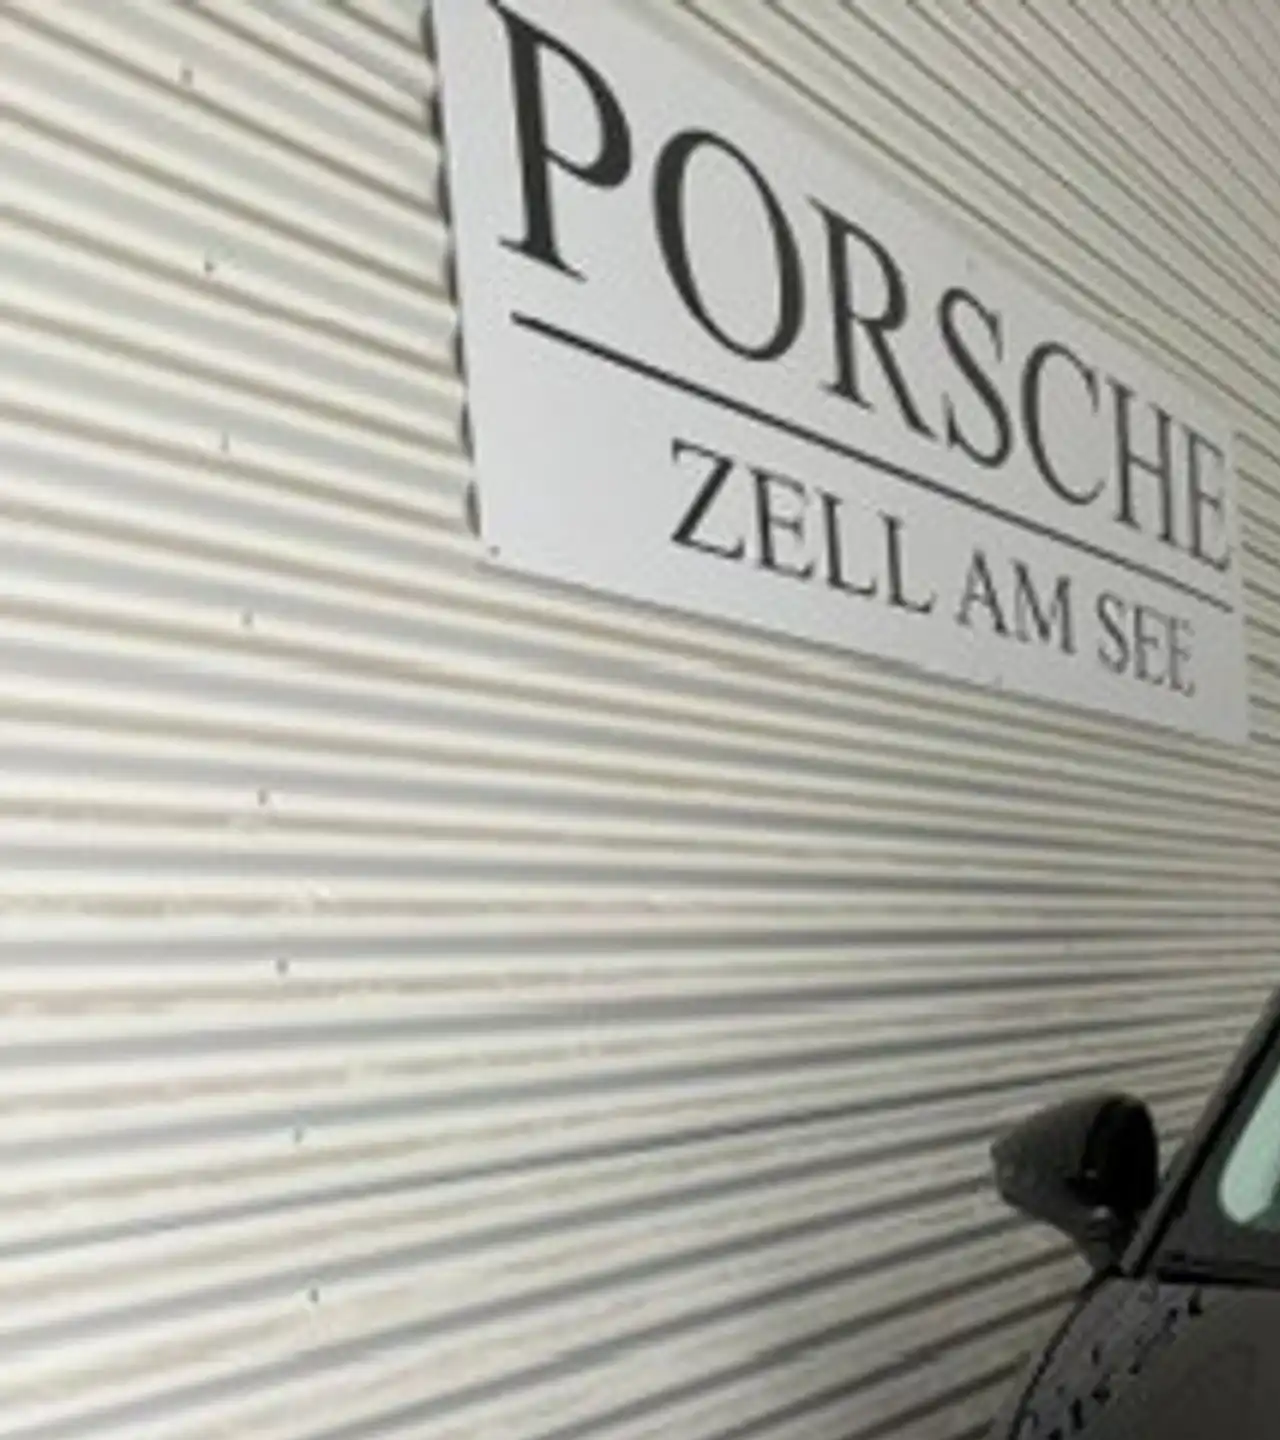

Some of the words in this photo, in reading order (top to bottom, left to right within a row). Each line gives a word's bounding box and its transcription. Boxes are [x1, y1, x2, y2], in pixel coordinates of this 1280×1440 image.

[488, 0, 1234, 572] PORSCHE
[670, 438, 937, 616] ZELL
[955, 550, 1078, 656] AM
[1097, 593, 1197, 699] SEE
